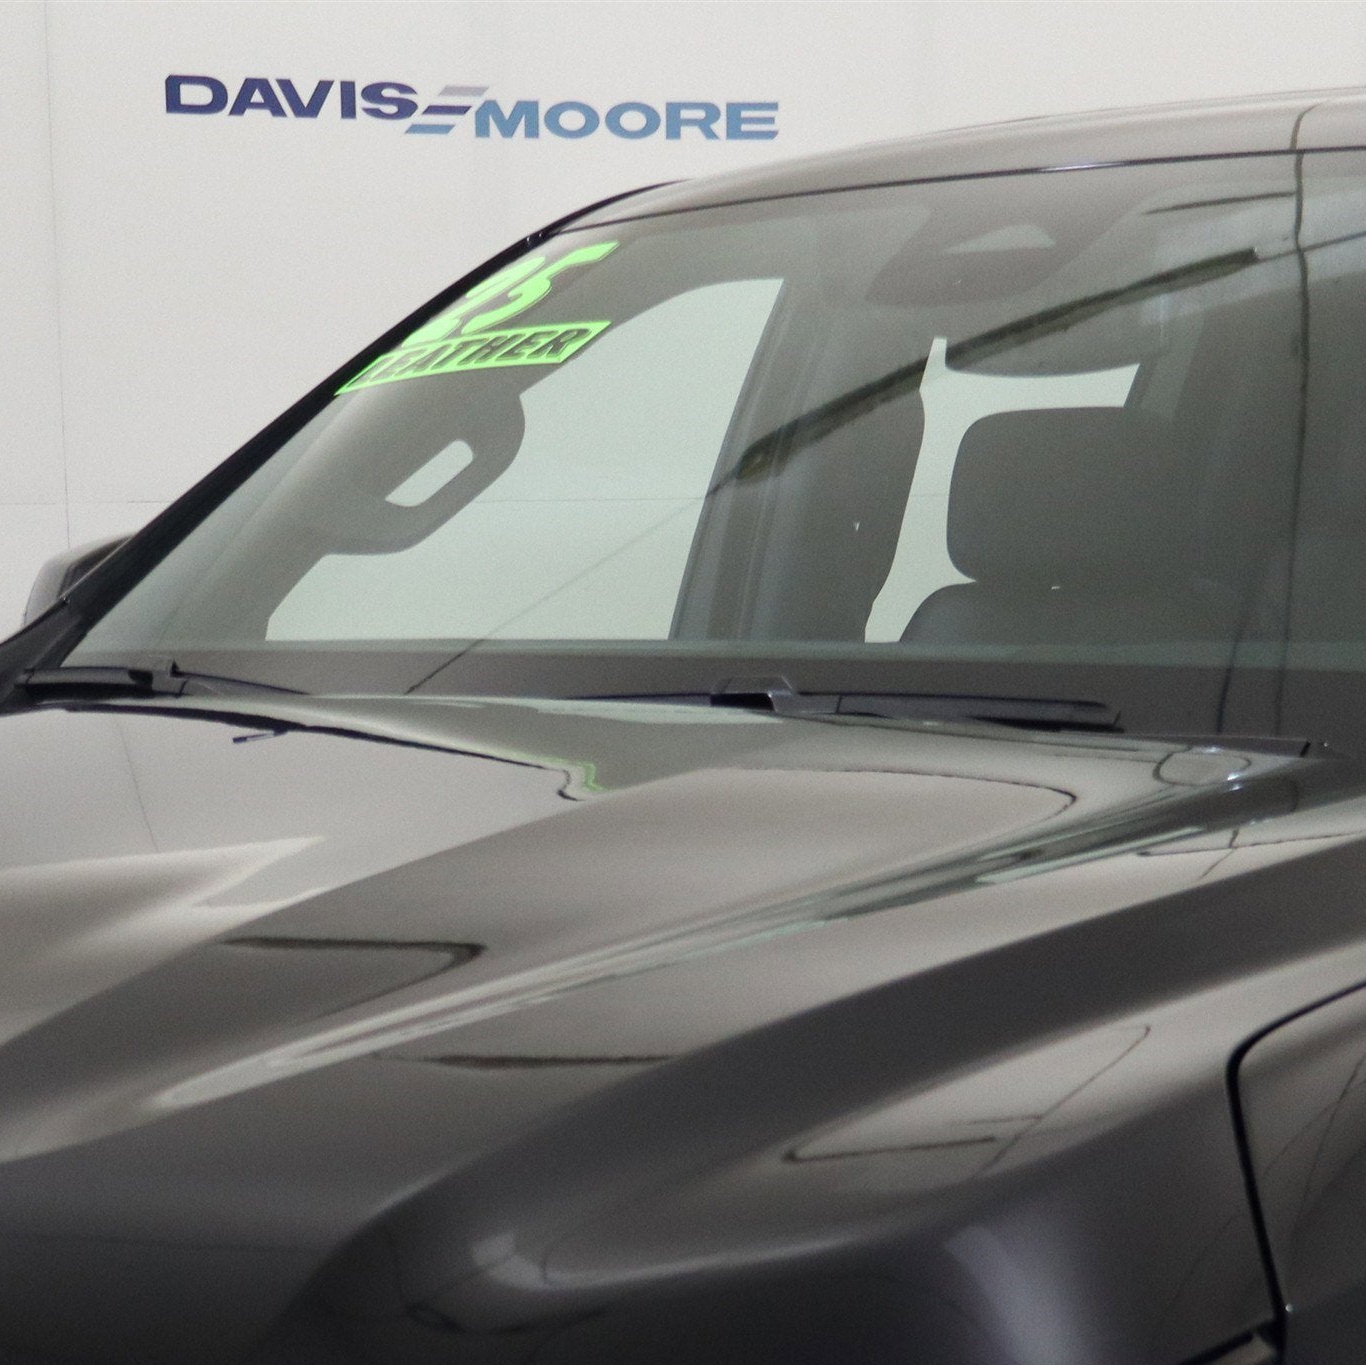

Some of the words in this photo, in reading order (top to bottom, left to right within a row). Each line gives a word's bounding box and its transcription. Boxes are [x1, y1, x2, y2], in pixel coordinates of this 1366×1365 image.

[165, 75, 419, 120] DAVIS
[474, 99, 779, 141] MOORE
[344, 327, 592, 388] LEATHER
